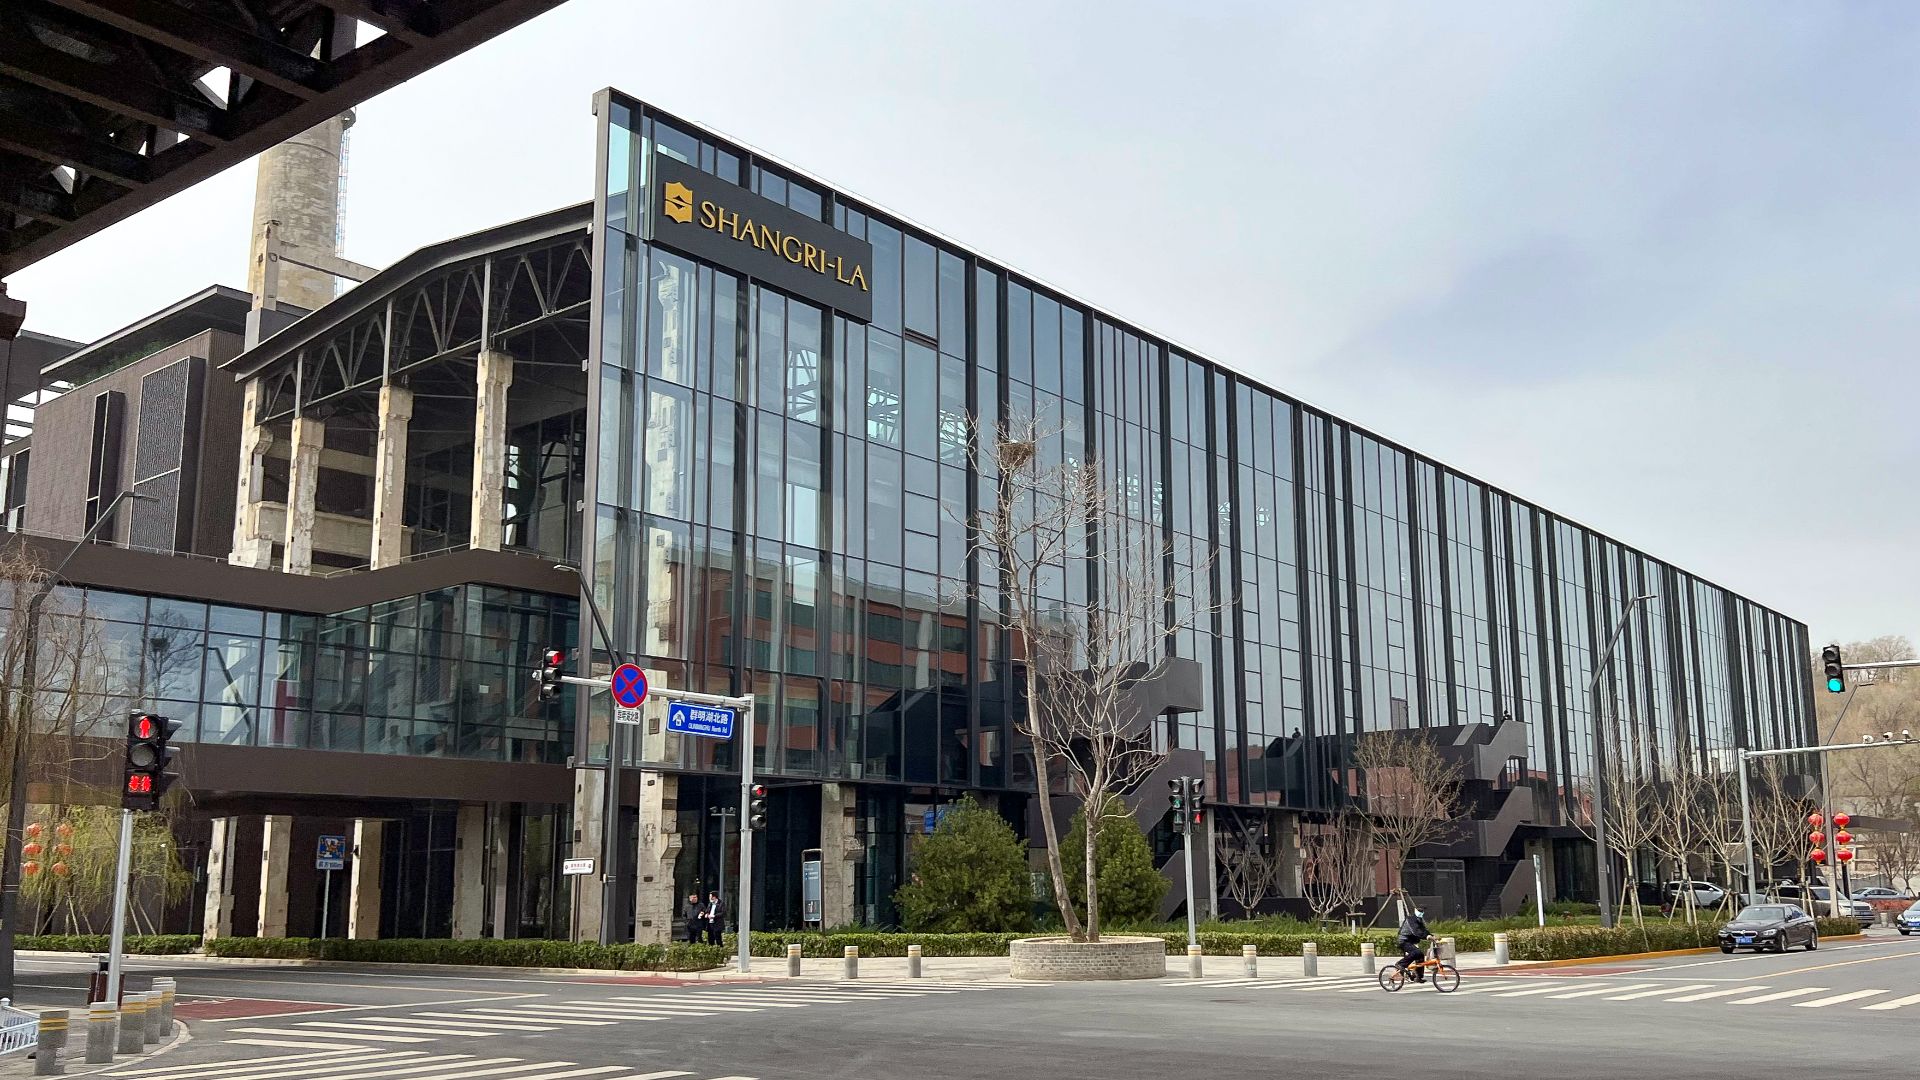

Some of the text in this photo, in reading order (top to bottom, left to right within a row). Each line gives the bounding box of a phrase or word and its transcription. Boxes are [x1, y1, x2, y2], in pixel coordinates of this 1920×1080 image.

[700, 201, 868, 291] SHANGRI-LA
[690, 709, 728, 725] 群明湖北路
